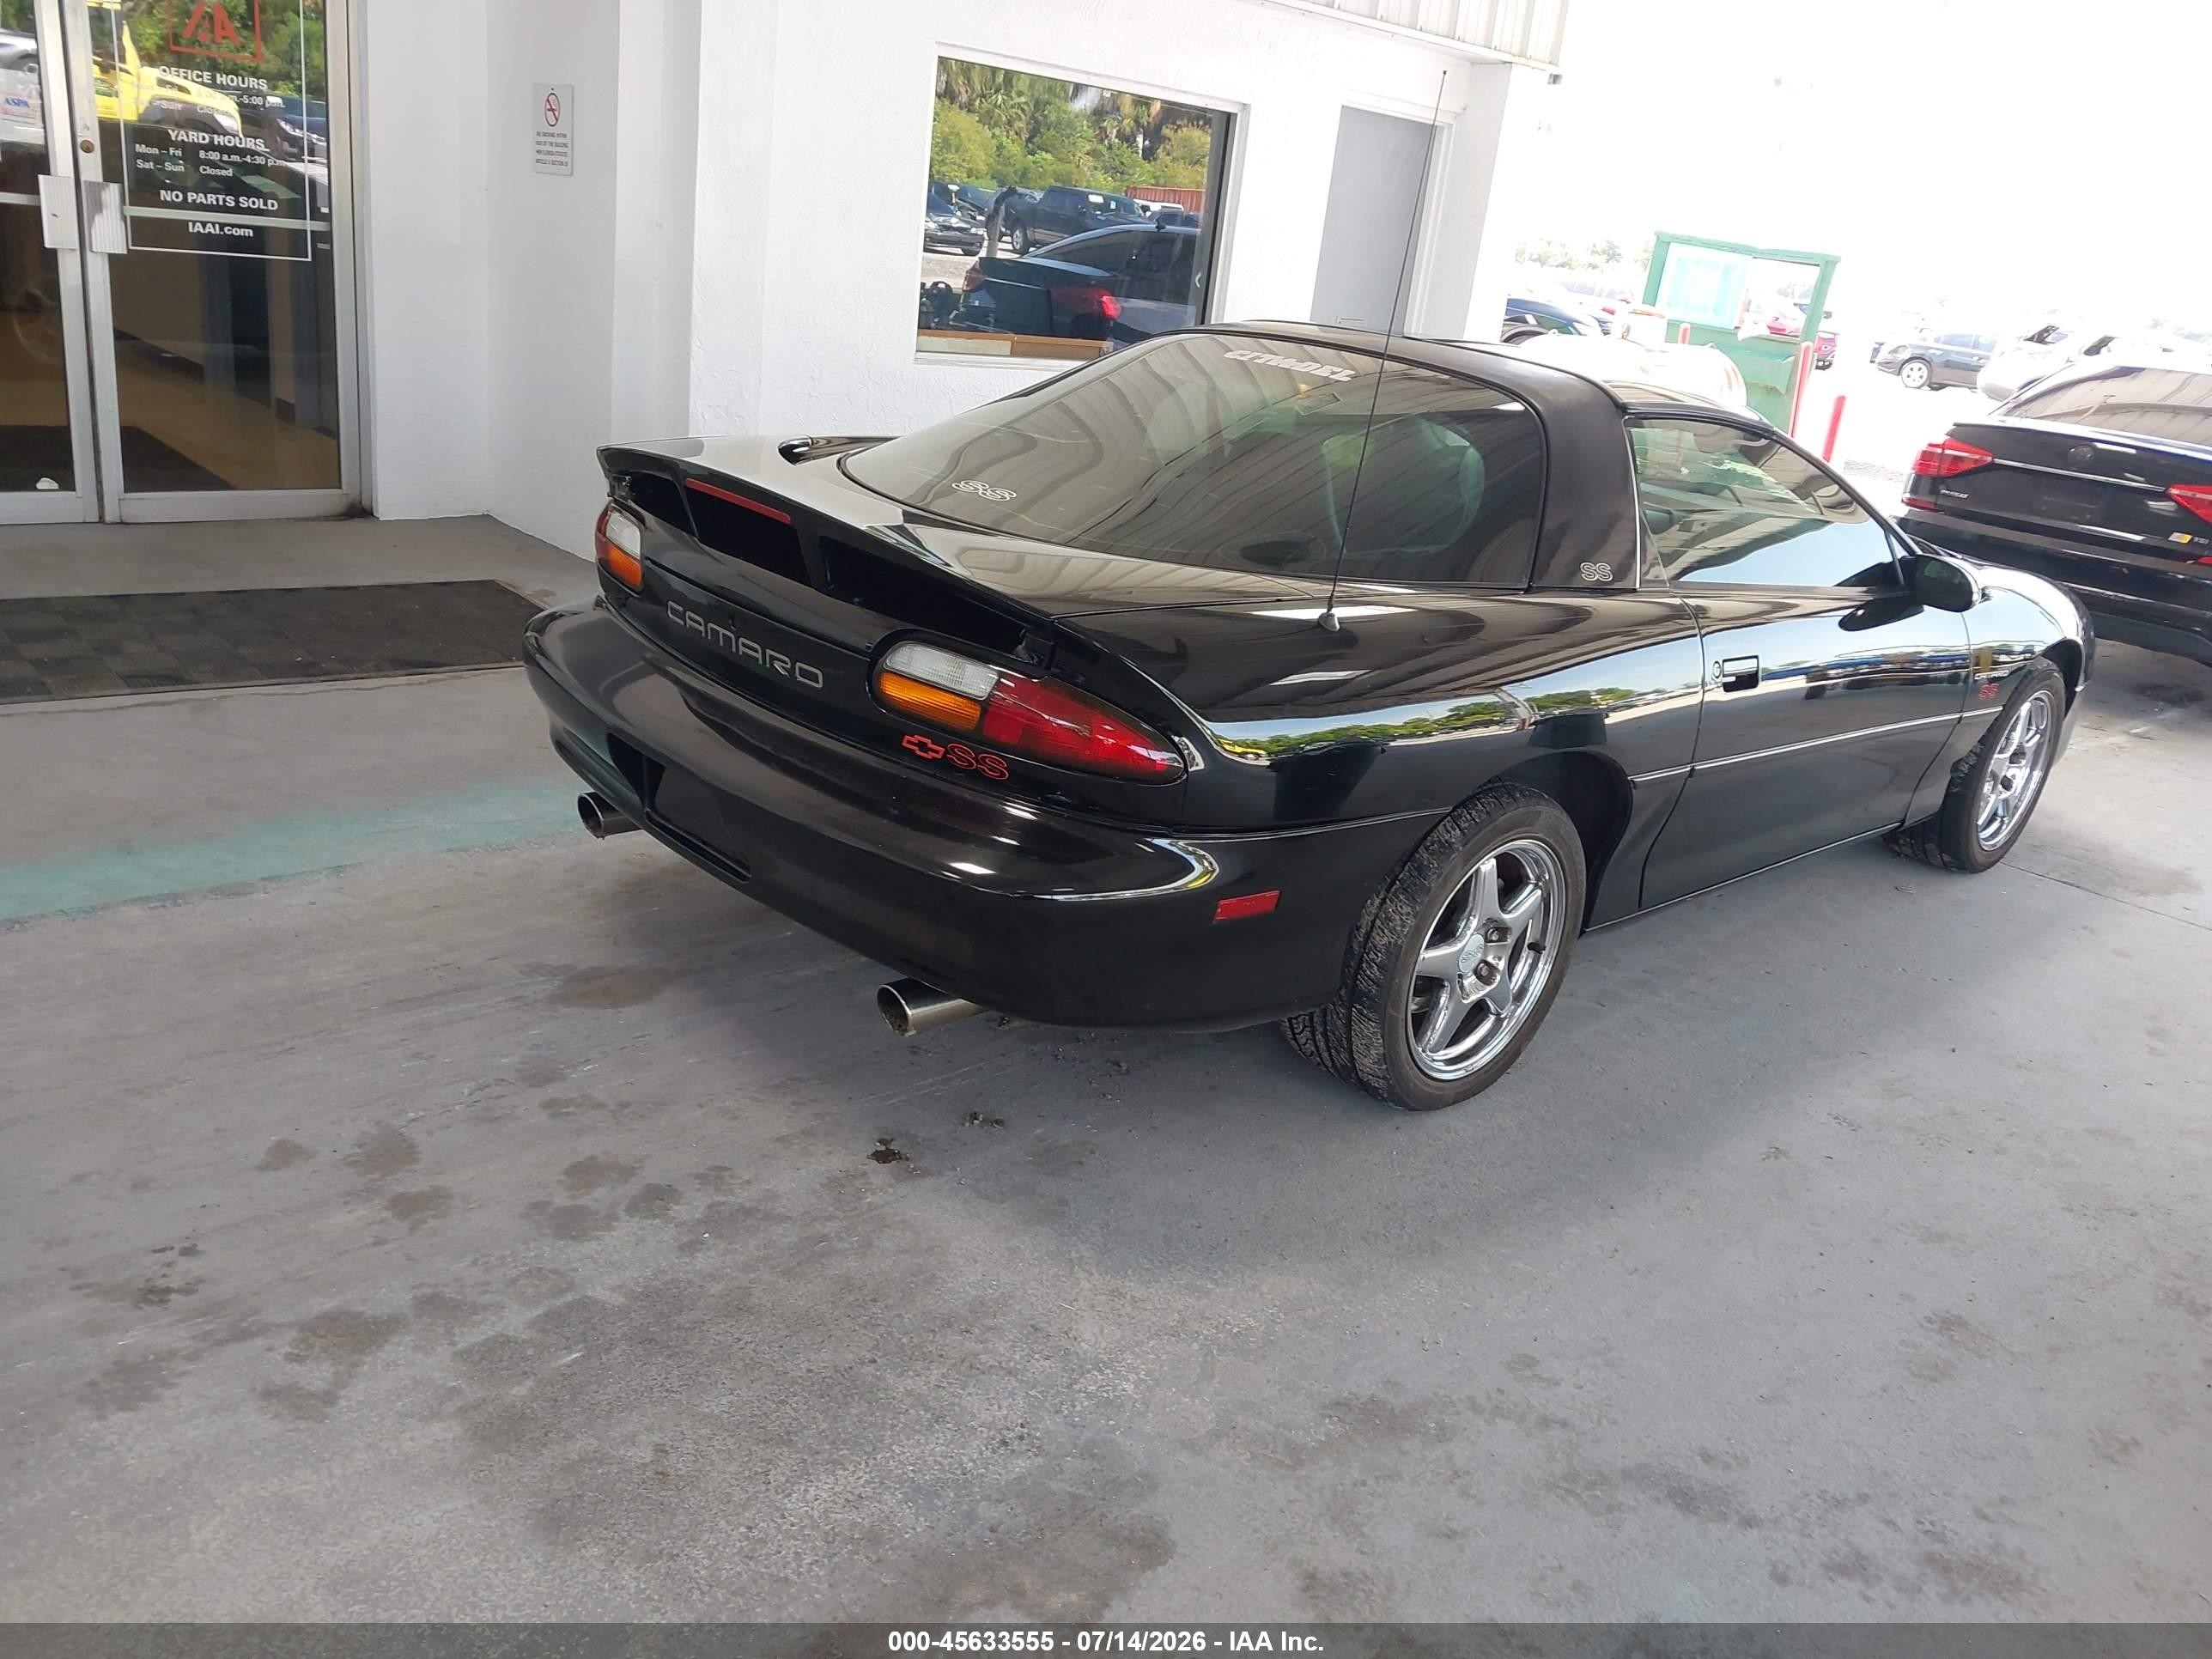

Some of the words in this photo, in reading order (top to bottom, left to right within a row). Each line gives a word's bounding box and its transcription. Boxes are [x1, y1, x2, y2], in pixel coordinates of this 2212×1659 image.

[158, 65, 212, 83] OFFICE
[216, 73, 268, 89] HOURS
[168, 130, 210, 144] YARD
[214, 134, 265, 150] HOURS
[135, 143, 159, 154] Mon
[169, 147, 182, 156] Fri
[199, 149, 220, 161] 8:00
[136, 159, 155, 169] Sat
[164, 161, 185, 172] Sun
[199, 165, 233, 177] Closed
[160, 189, 183, 203] NO
[187, 191, 235, 207] PARTS
[239, 197, 279, 210] SOLD
[187, 221, 254, 237] IAAI.com
[951, 480, 1017, 501] SS
[1580, 562, 1613, 581] SS
[667, 600, 824, 689] CAMARO
[946, 743, 1009, 780] SS
